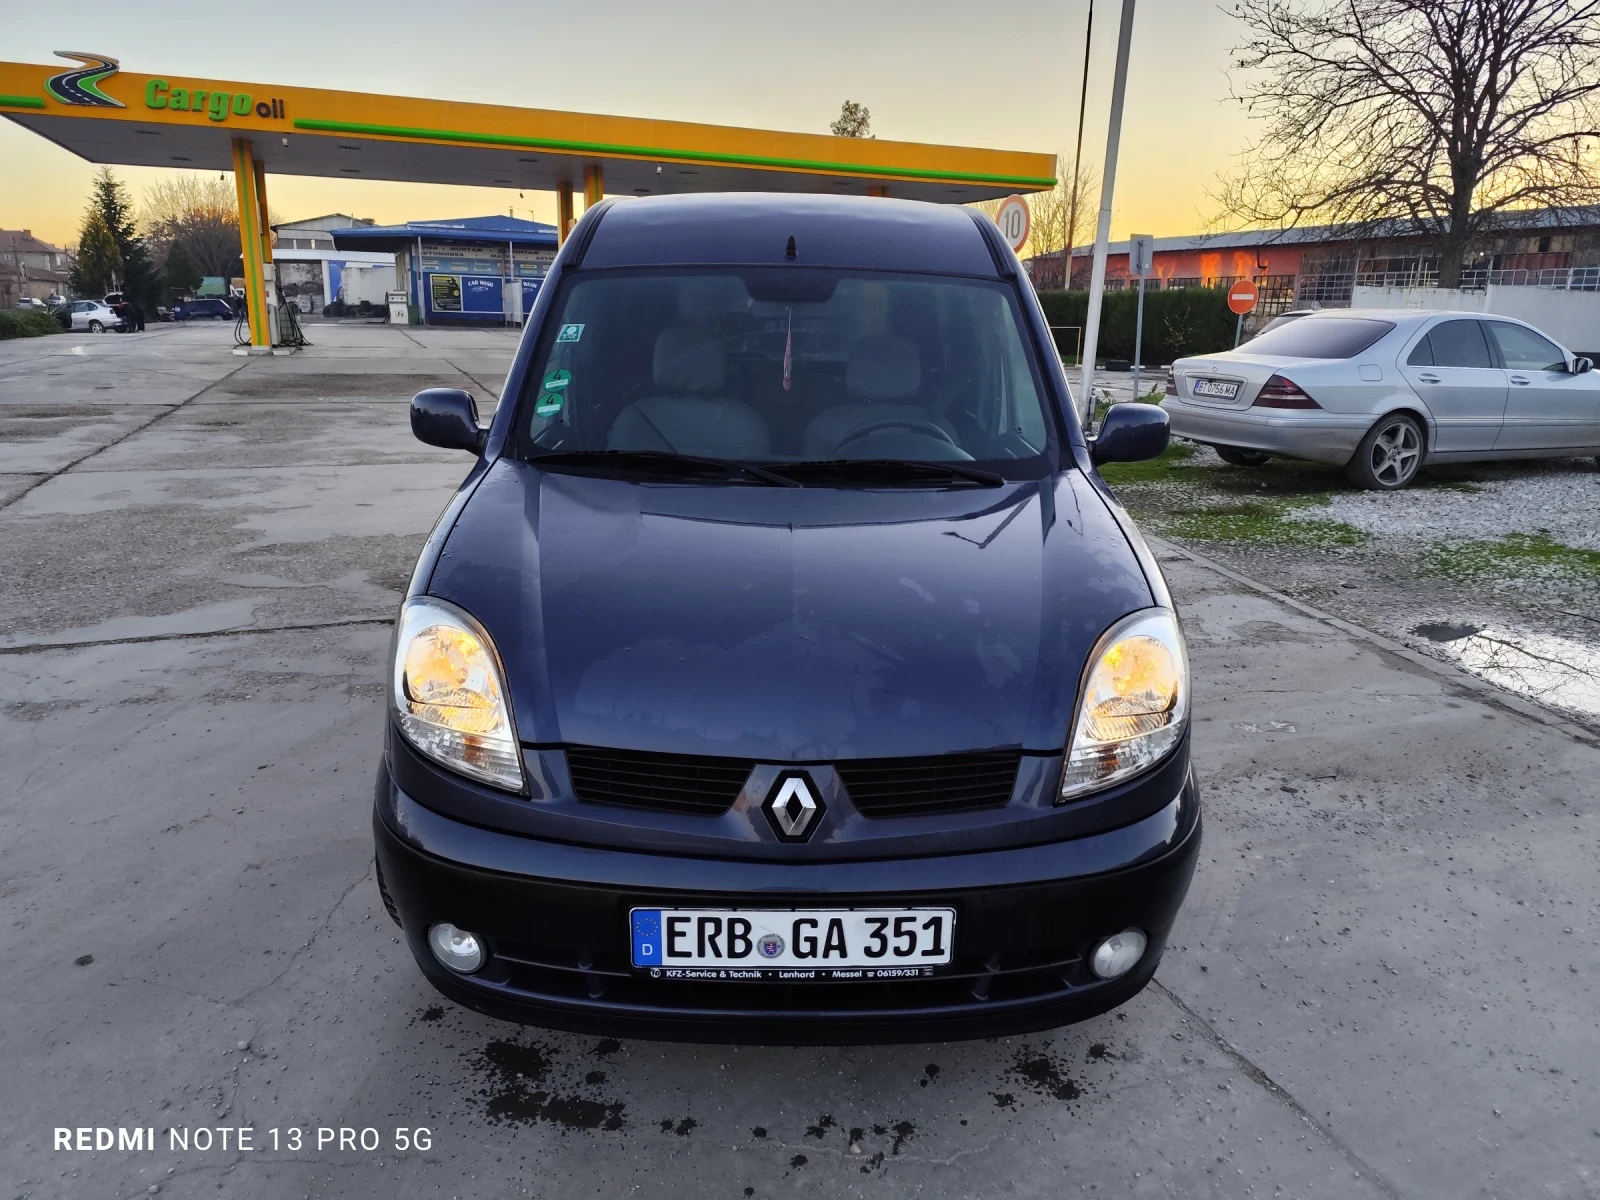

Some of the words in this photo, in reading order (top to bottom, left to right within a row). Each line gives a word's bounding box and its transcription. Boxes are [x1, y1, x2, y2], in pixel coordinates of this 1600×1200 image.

[145, 79, 252, 122] Cargo
[256, 98, 285, 119] oil
[1004, 209, 1021, 239] 10
[479, 280, 494, 288] WASH
[522, 281, 538, 289] WASH
[553, 369, 562, 381] 4
[1207, 383, 1224, 395] 0756
[1224, 385, 1236, 396] MA
[545, 394, 554, 405] 4
[666, 916, 753, 959] ERB
[792, 917, 848, 959] GA
[863, 916, 945, 959] 351
[642, 943, 653, 956] D
[666, 970, 717, 978] KFZ-Service
[729, 970, 762, 979] Technik
[779, 970, 815, 978] Lenhard
[832, 970, 862, 978] Messel
[877, 969, 919, 977] 06159/331
